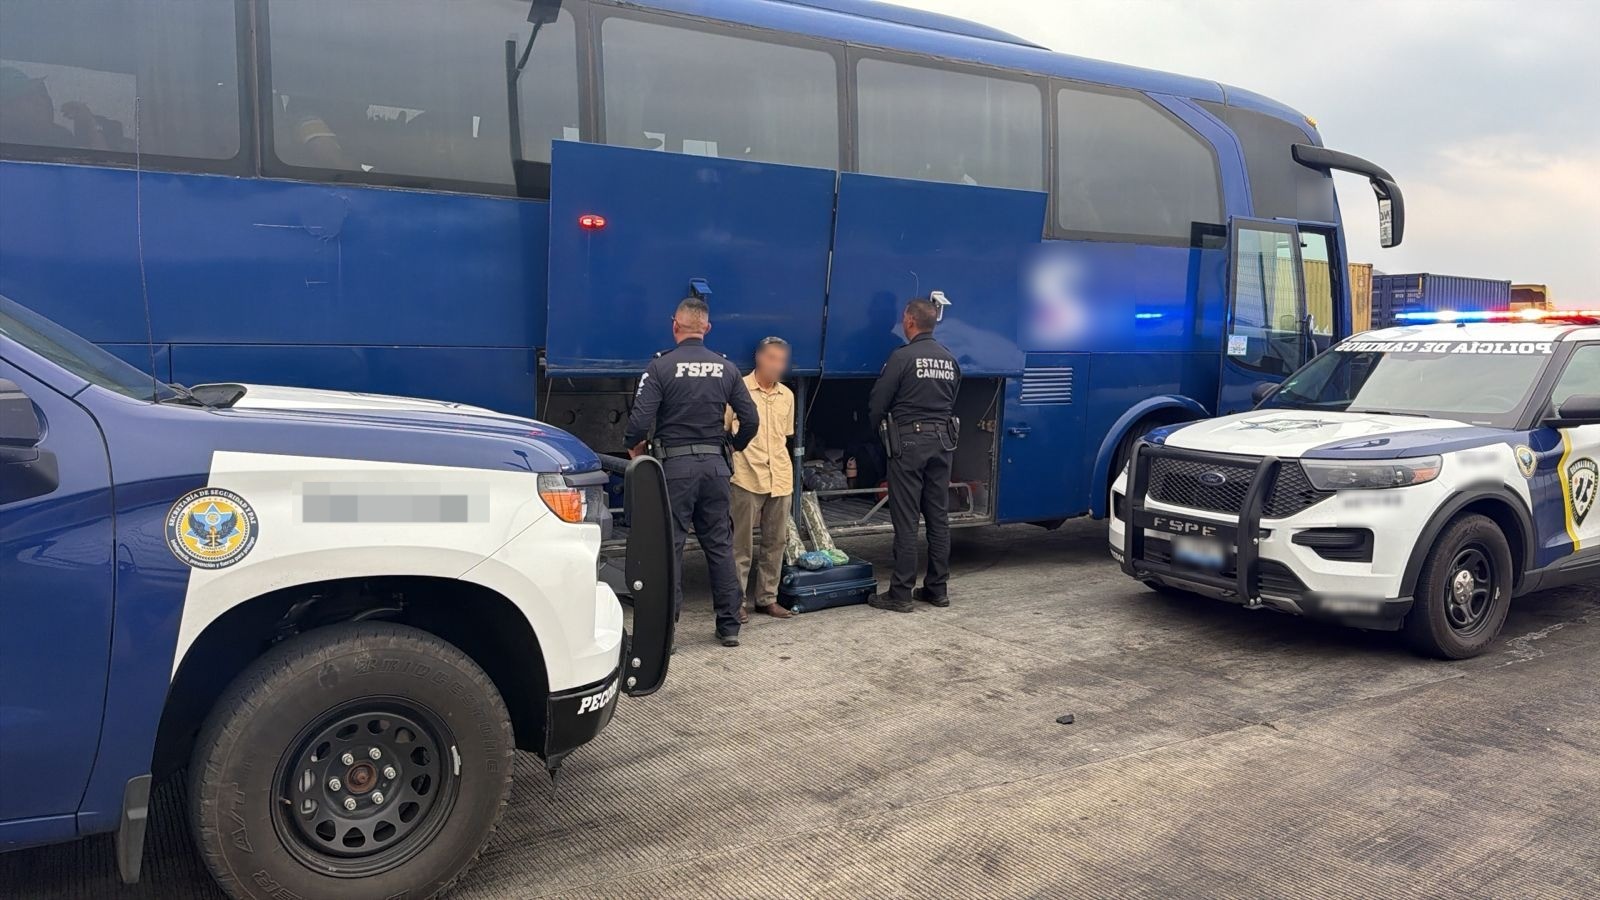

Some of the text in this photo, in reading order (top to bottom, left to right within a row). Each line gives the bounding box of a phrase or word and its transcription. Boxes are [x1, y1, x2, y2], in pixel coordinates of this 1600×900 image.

[675, 362, 724, 378] FSPE
[916, 358, 954, 370] ESTATAL
[916, 368, 955, 381] CAMINOS
[1153, 517, 1217, 537] FSPE
